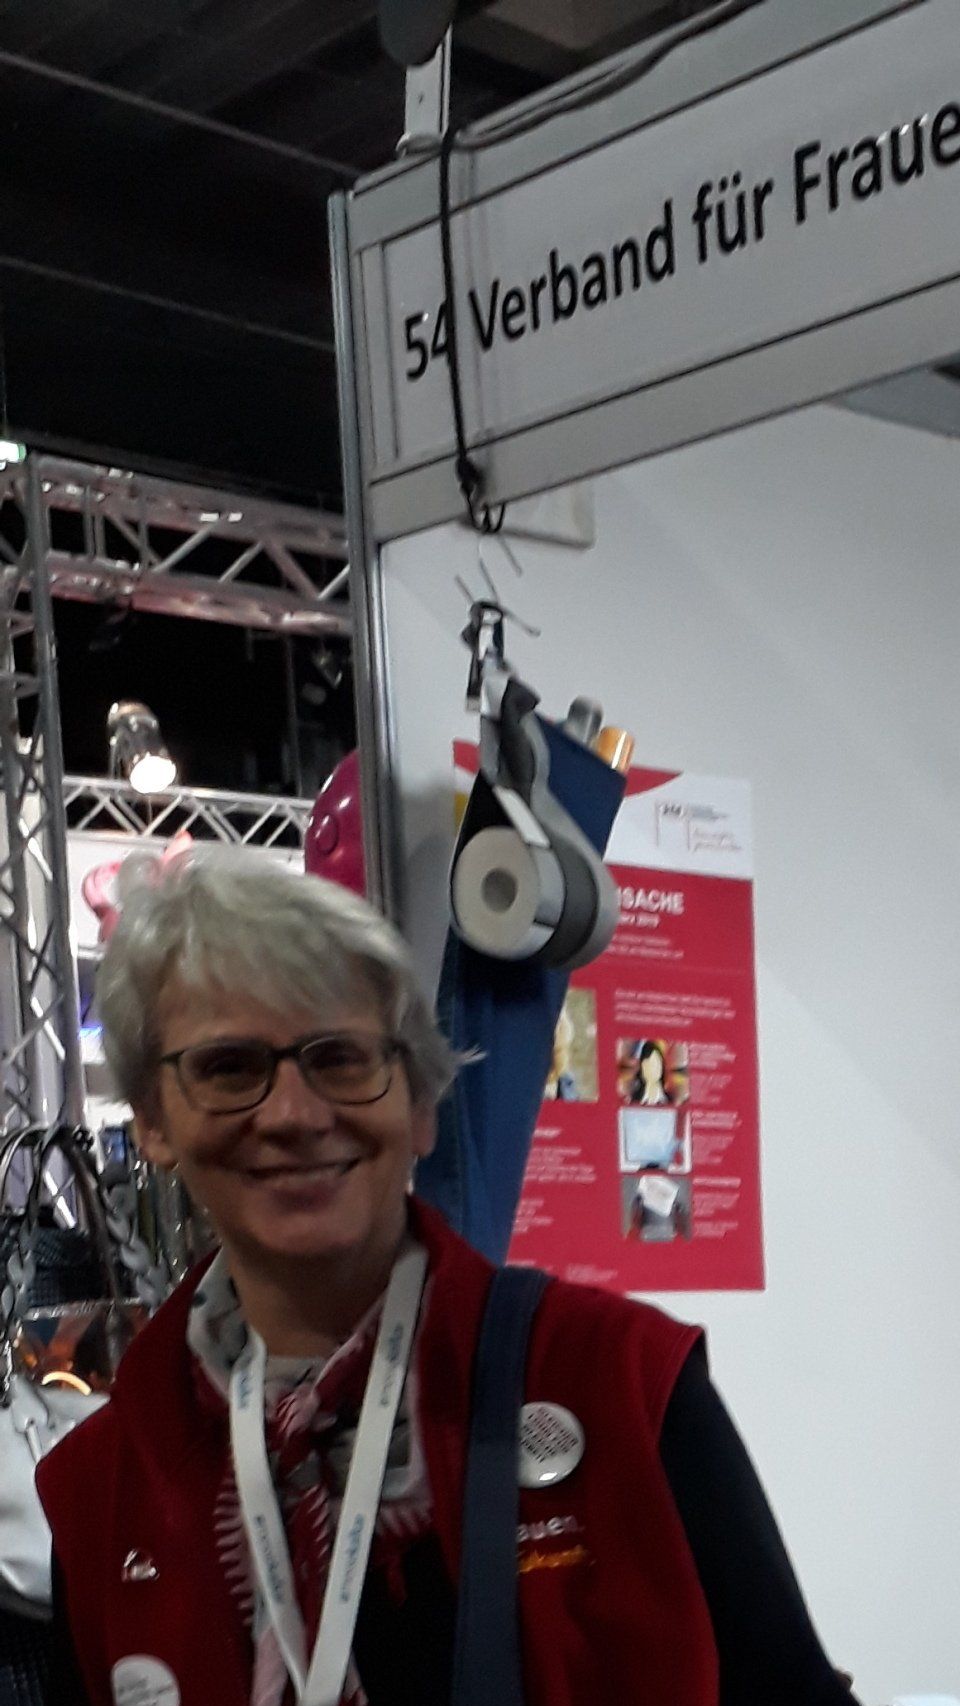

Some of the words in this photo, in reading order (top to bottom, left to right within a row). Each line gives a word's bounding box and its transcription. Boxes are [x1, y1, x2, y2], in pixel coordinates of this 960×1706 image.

[403, 300, 454, 382] 54
[469, 199, 676, 352] Verband
[691, 170, 774, 265] für
